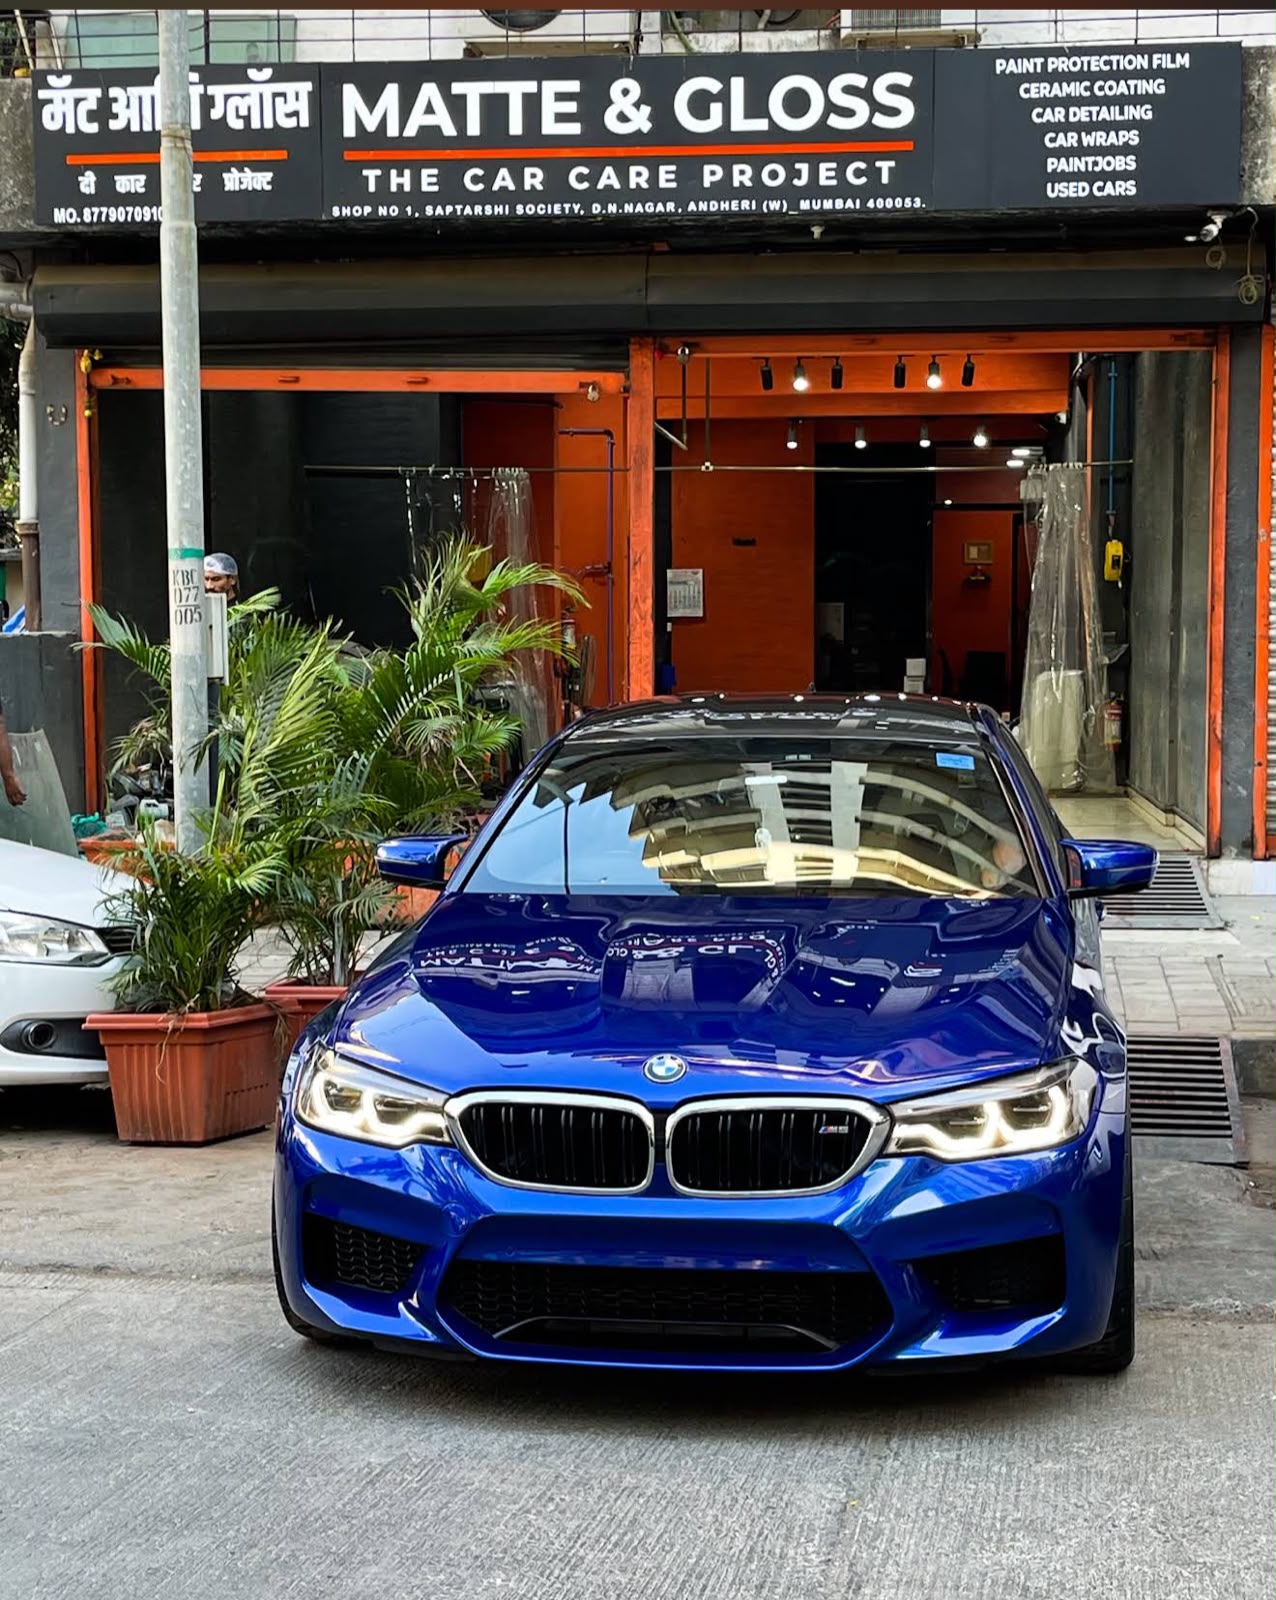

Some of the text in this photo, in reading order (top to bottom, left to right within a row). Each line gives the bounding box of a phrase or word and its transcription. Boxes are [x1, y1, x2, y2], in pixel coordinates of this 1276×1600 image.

[995, 52, 1190, 75] PAINT PROTECTION FILM
[1018, 77, 1166, 99] CERAMIC COATING
[37, 74, 103, 134] मॅट
[206, 67, 313, 130] ग्लॉस
[342, 71, 916, 138] MATTE & GLOSS
[1031, 104, 1153, 124] CAR DETAILING
[1044, 129, 1140, 149] CAR WRAPS
[1046, 154, 1137, 173] PAINTJOBS
[77, 170, 97, 195] दी
[113, 174, 147, 194] कार
[221, 166, 274, 192] प्रोजेक्ट
[361, 160, 896, 193] THE CAR CARE PROJECT
[1046, 179, 1137, 199] USED CARS
[331, 205, 373, 218] SHOP
[378, 205, 399, 217] NO
[405, 205, 420, 218] 1,
[425, 204, 510, 217] SAPTARSHI
[687, 199, 757, 212] ANDHERI
[799, 198, 861, 211] MUMBAI
[866, 196, 926, 209] 400053.
[174, 604, 202, 625] 005
